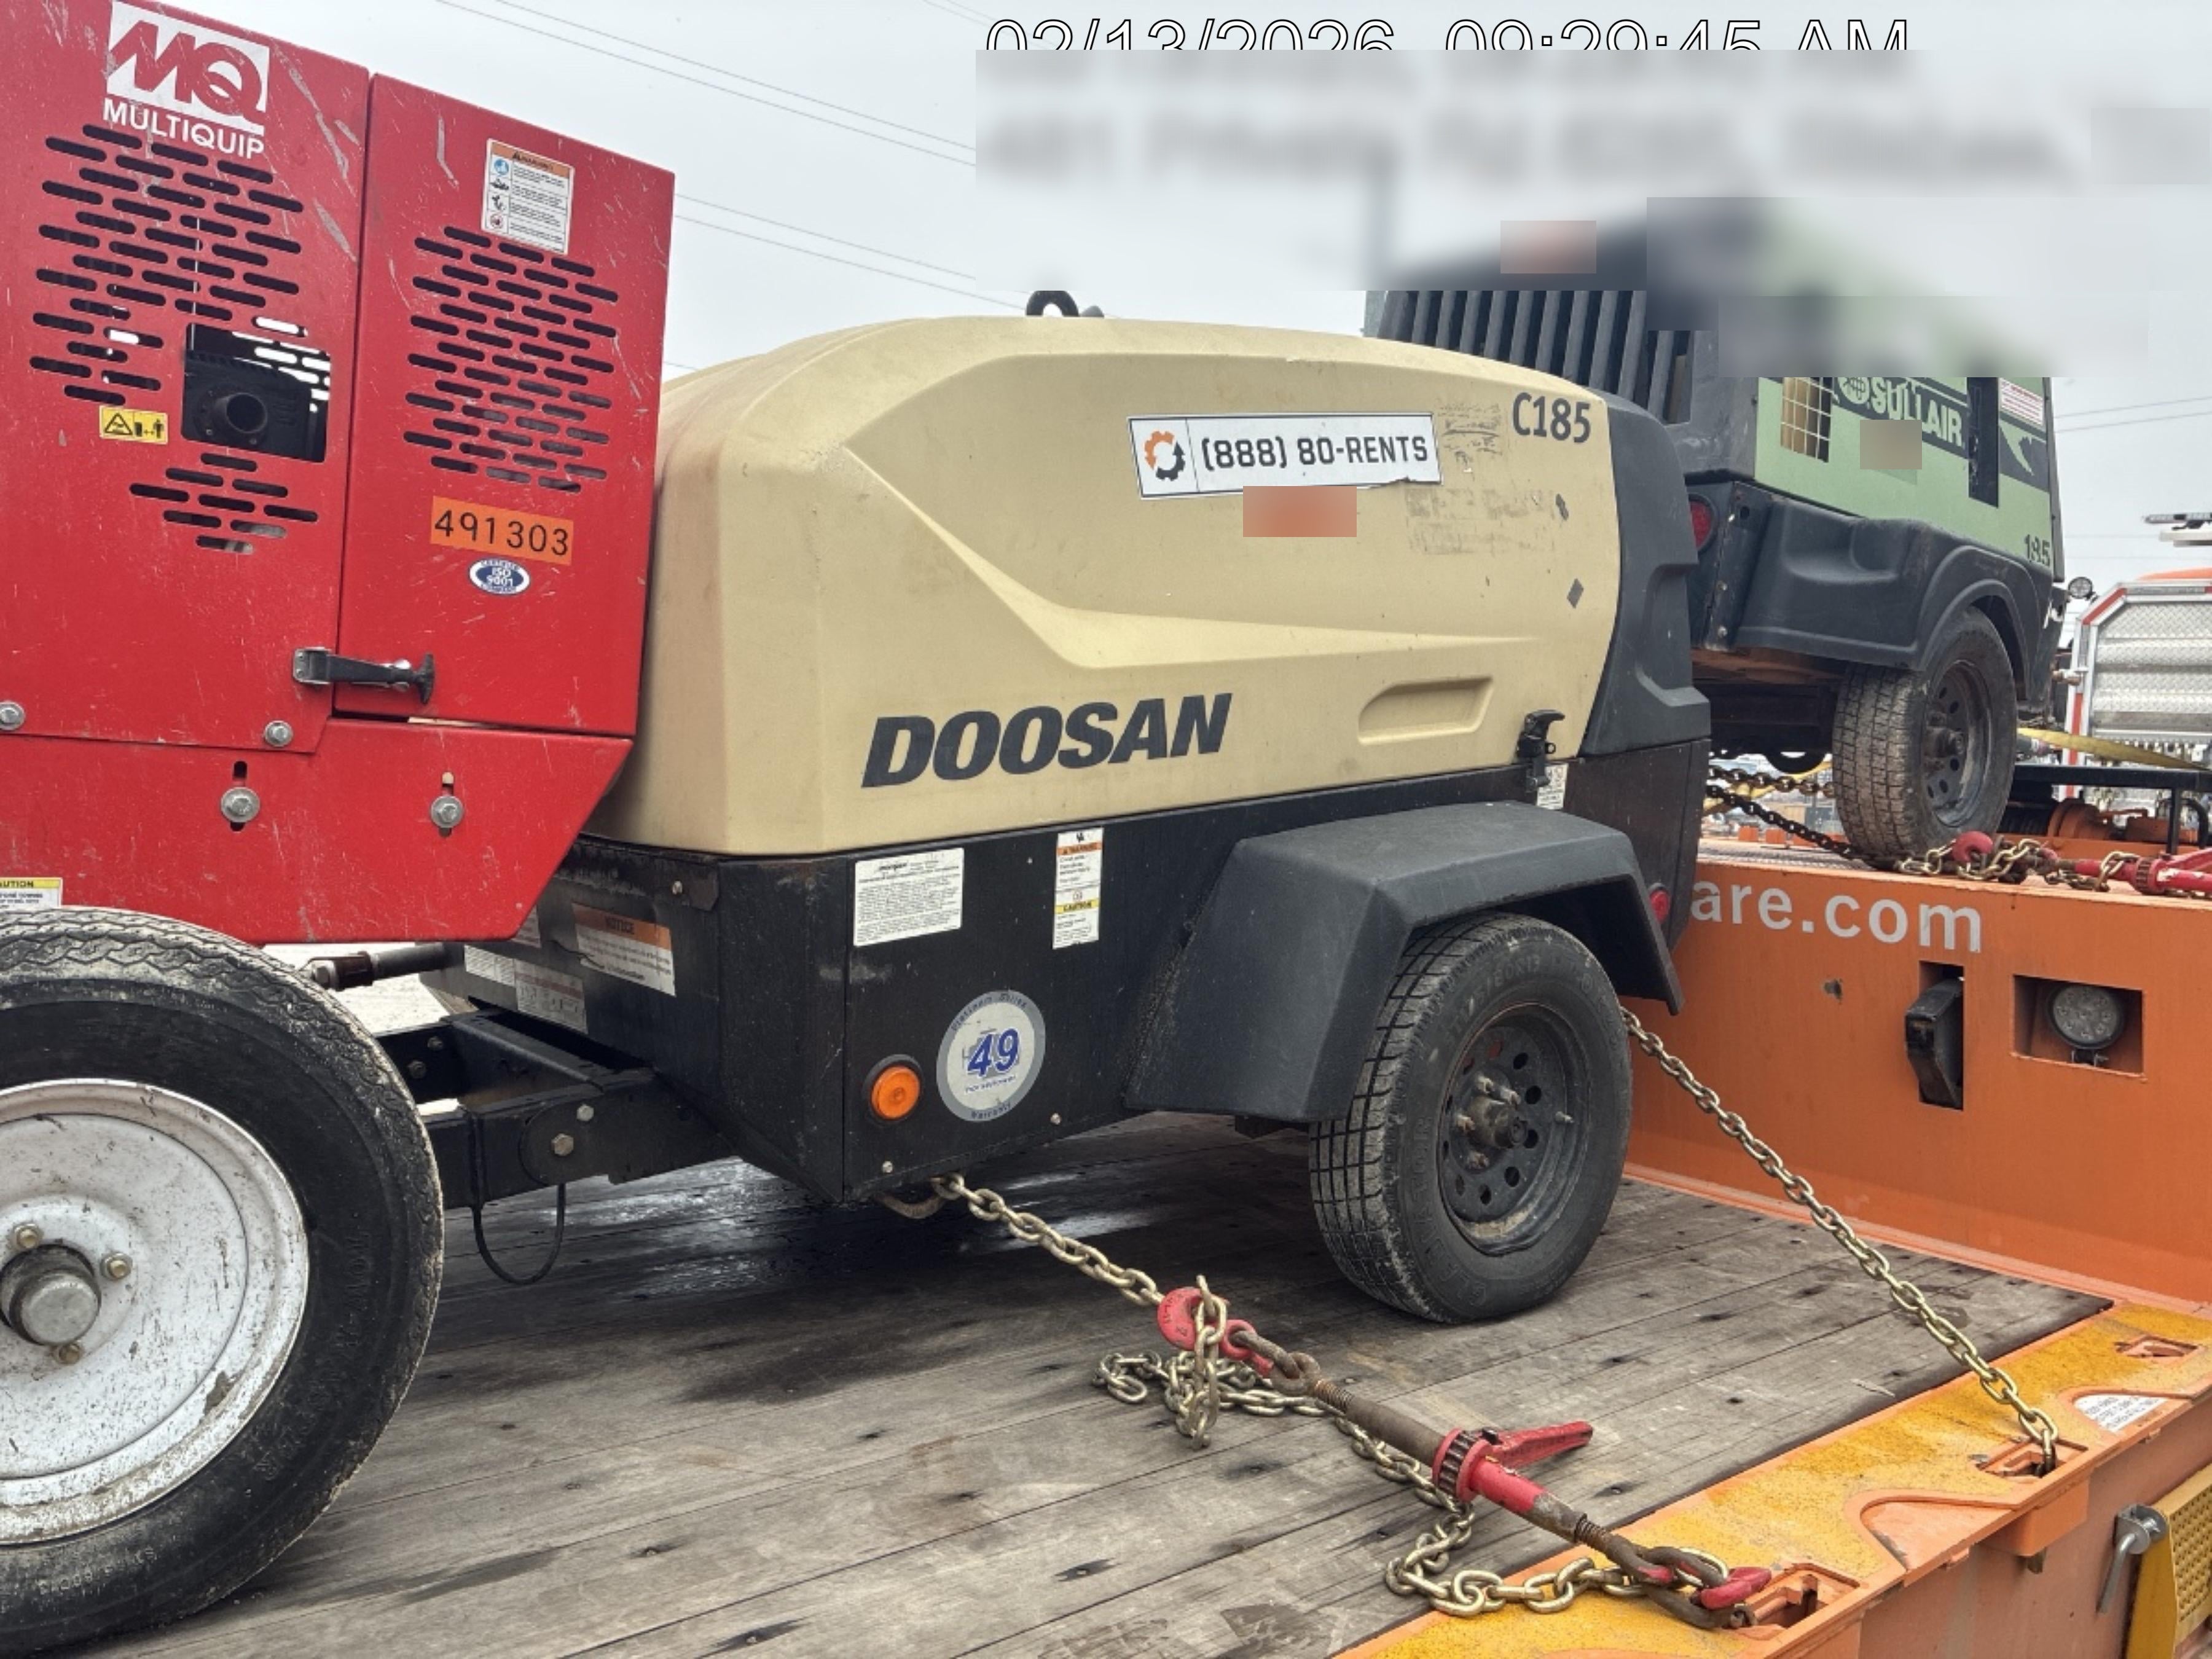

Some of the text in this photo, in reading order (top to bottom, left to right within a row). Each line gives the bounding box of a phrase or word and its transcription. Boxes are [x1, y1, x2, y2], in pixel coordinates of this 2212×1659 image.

[107, 20, 263, 128] MQ
[103, 97, 264, 159] MULTIQUIP
[1512, 391, 1592, 444] C185
[1201, 435, 1429, 471] (888) 80-RENTS
[434, 509, 569, 556] 491303
[2025, 533, 2052, 567] 185
[861, 692, 1233, 788] DOOSAN
[0, 880, 34, 889] UTION
[1690, 880, 1982, 953] are.com
[967, 1028, 1018, 1077] 49
